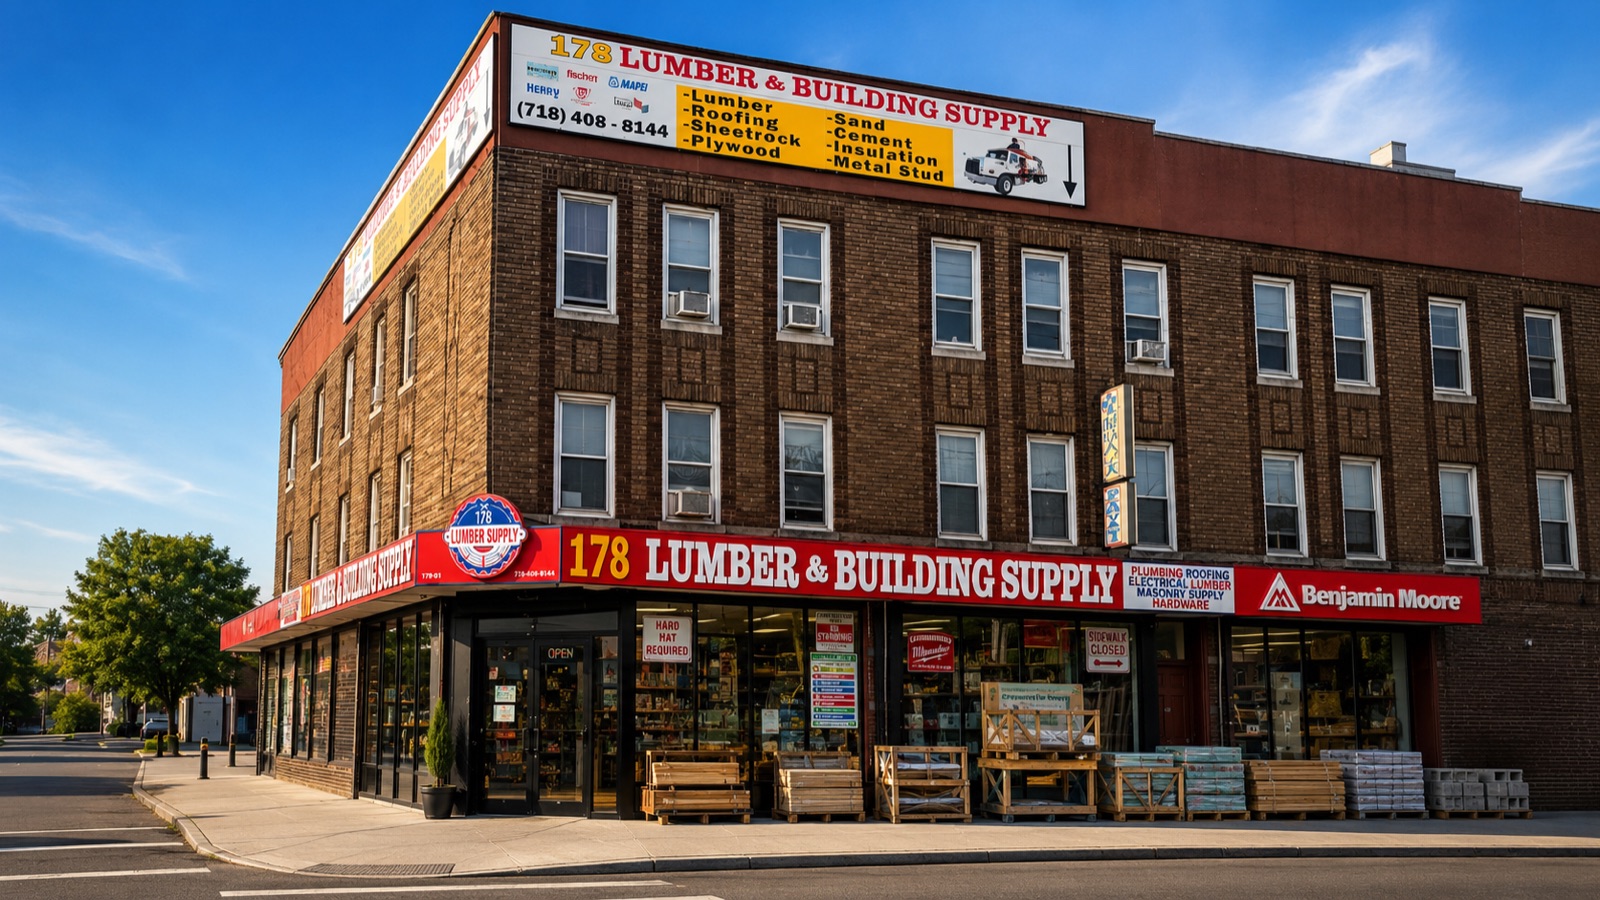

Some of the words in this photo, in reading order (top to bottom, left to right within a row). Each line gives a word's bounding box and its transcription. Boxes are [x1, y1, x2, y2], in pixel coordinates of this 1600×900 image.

[551, 34, 613, 64] 178
[619, 46, 758, 90] LUMBER
[765, 75, 786, 91] &
[792, 76, 938, 120] BUILDING
[945, 103, 1051, 137] SUPPLY
[620, 79, 648, 92] MAPEI
[517, 101, 566, 125] (718)
[571, 111, 607, 129] 408
[622, 119, 669, 138] 8144
[899, 165, 944, 182] Stud
[475, 510, 492, 524] 178
[451, 528, 484, 544] LUMBER
[487, 527, 518, 544] SUPPLY
[377, 539, 415, 591] SUPPLY
[569, 533, 630, 580] 178
[646, 538, 800, 589] LUMBER
[805, 554, 829, 583] &
[834, 549, 995, 598] BUILDING
[1001, 559, 1118, 604] SUPPLY
[1131, 566, 1183, 578] PLUMBING
[1186, 569, 1229, 580] ROOFING
[1128, 576, 1188, 589] ELECTRICAL
[1190, 579, 1231, 591] LUMBER
[1137, 587, 1186, 599] MASONRY
[1188, 589, 1224, 601] SUPPLY
[1301, 584, 1395, 612] Benjamin
[1398, 589, 1461, 610] Moore
[1152, 598, 1210, 610] HARDWARE
[656, 620, 680, 631] HARD
[659, 633, 677, 642] HAT
[1088, 631, 1127, 643] SIDEWALK
[547, 647, 574, 659] OPEN
[646, 645, 688, 656] REQUIRED
[1091, 645, 1125, 656] CLOSED
